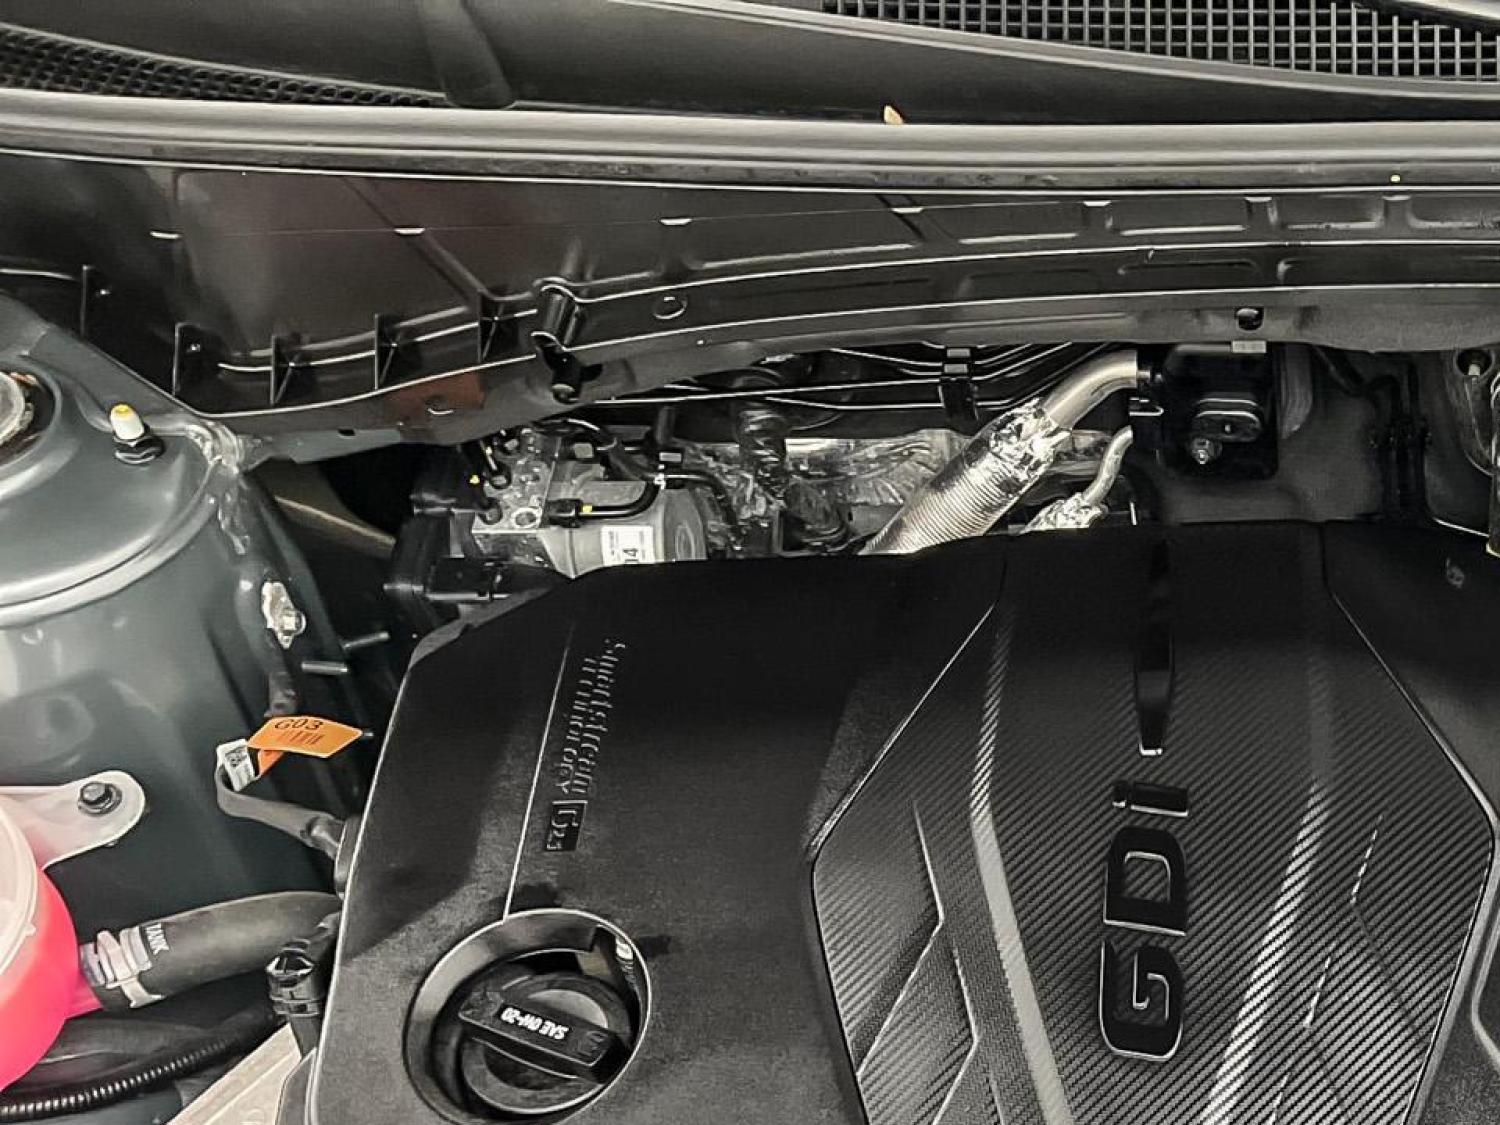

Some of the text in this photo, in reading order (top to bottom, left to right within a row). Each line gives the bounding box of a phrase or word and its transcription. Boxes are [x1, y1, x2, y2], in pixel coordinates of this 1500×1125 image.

[274, 717, 324, 731] G03
[500, 1007, 569, 1040] SAE 0W-20
